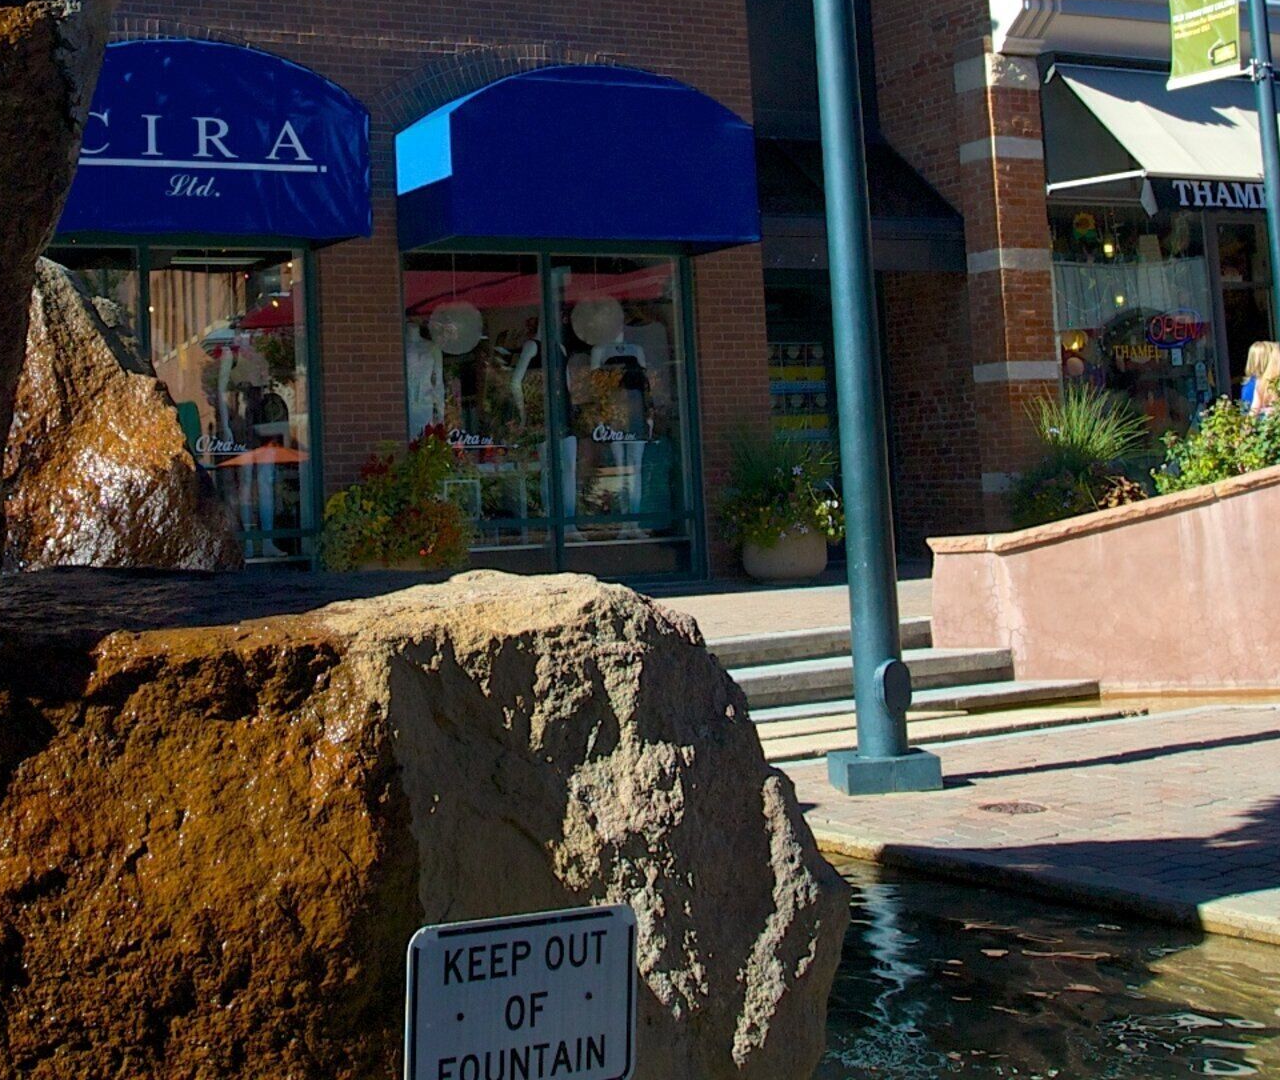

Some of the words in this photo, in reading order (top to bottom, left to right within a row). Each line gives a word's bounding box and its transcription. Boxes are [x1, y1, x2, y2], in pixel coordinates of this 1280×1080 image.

[165, 174, 221, 198] Ltd.
[1150, 316, 1198, 341] OPEN
[443, 940, 532, 986] KEEP
[545, 930, 608, 971] OUT
[504, 991, 549, 1031] OF
[438, 1033, 606, 1080] FOUNTAIN
